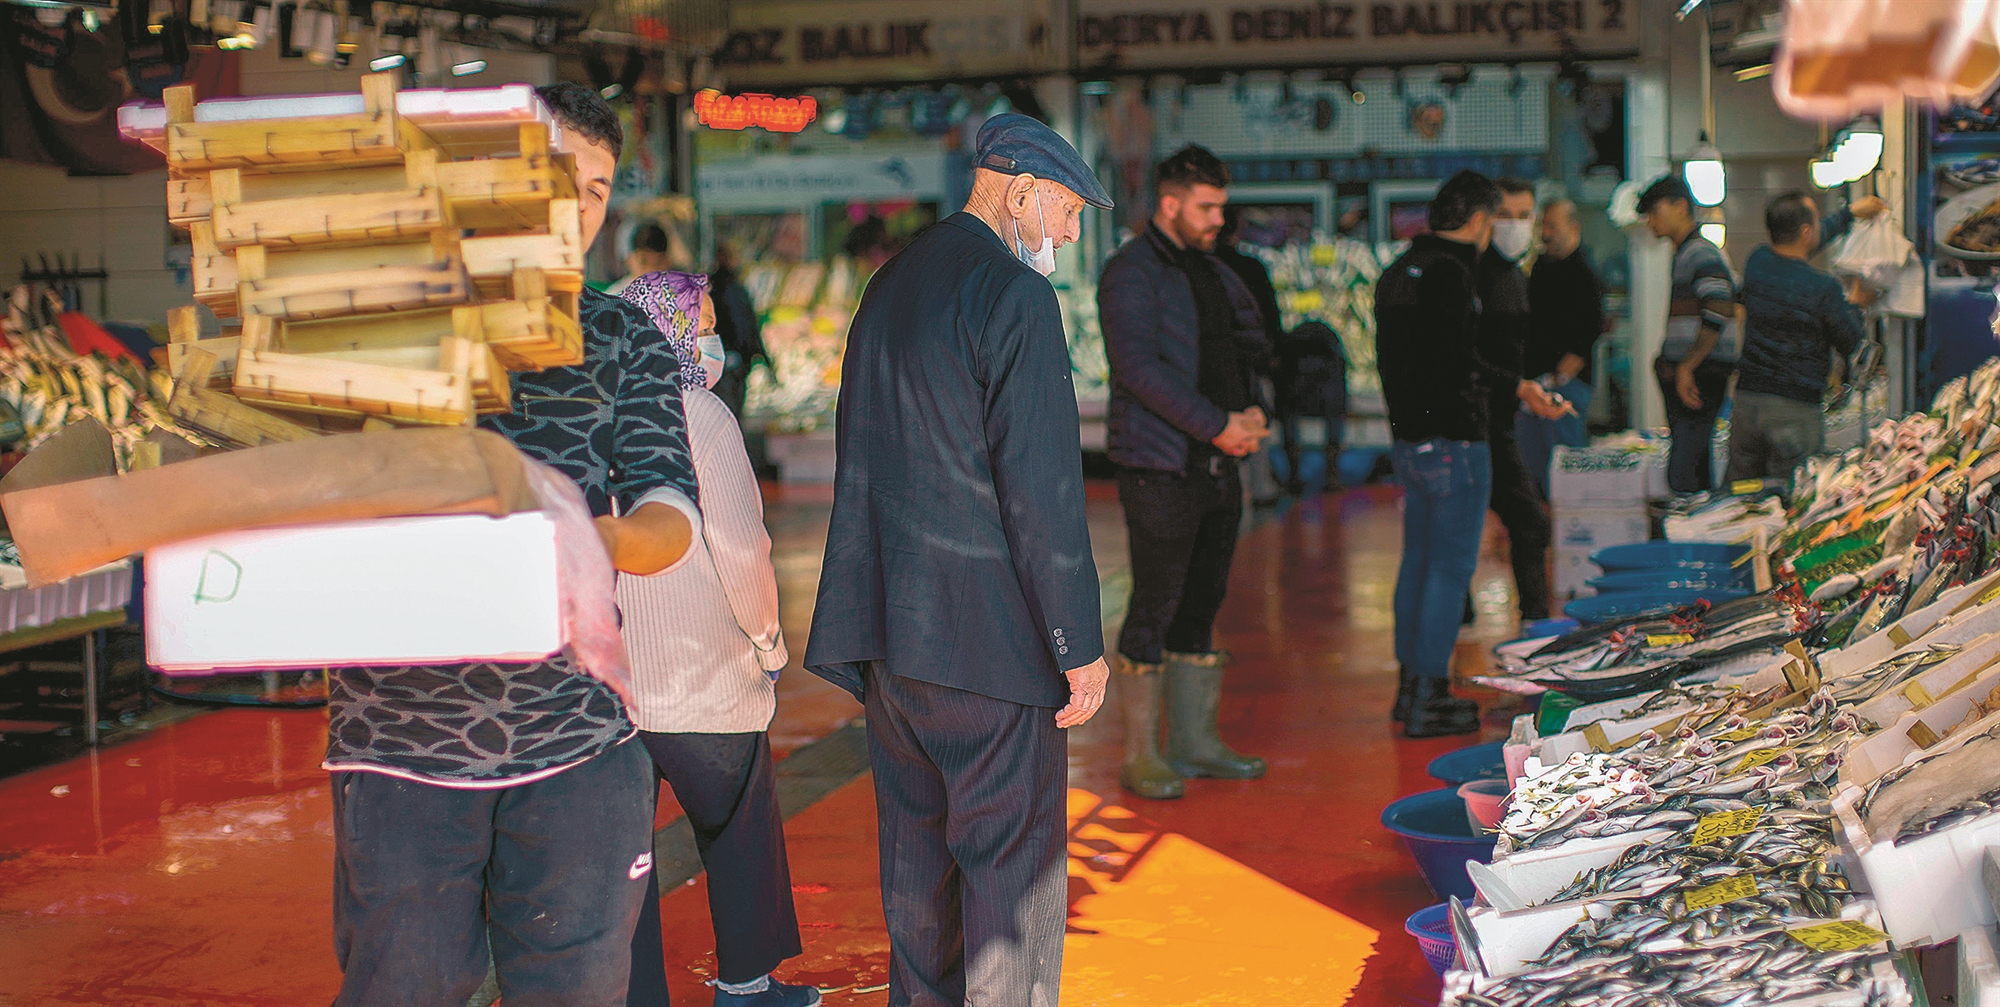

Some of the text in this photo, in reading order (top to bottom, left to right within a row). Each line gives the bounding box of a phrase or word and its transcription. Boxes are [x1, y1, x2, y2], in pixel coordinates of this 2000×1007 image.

[1078, 13, 1214, 46] DERYA
[1231, 1, 1357, 40] DENİZ
[1601, 0, 1626, 30] 2
[192, 548, 243, 605] D
